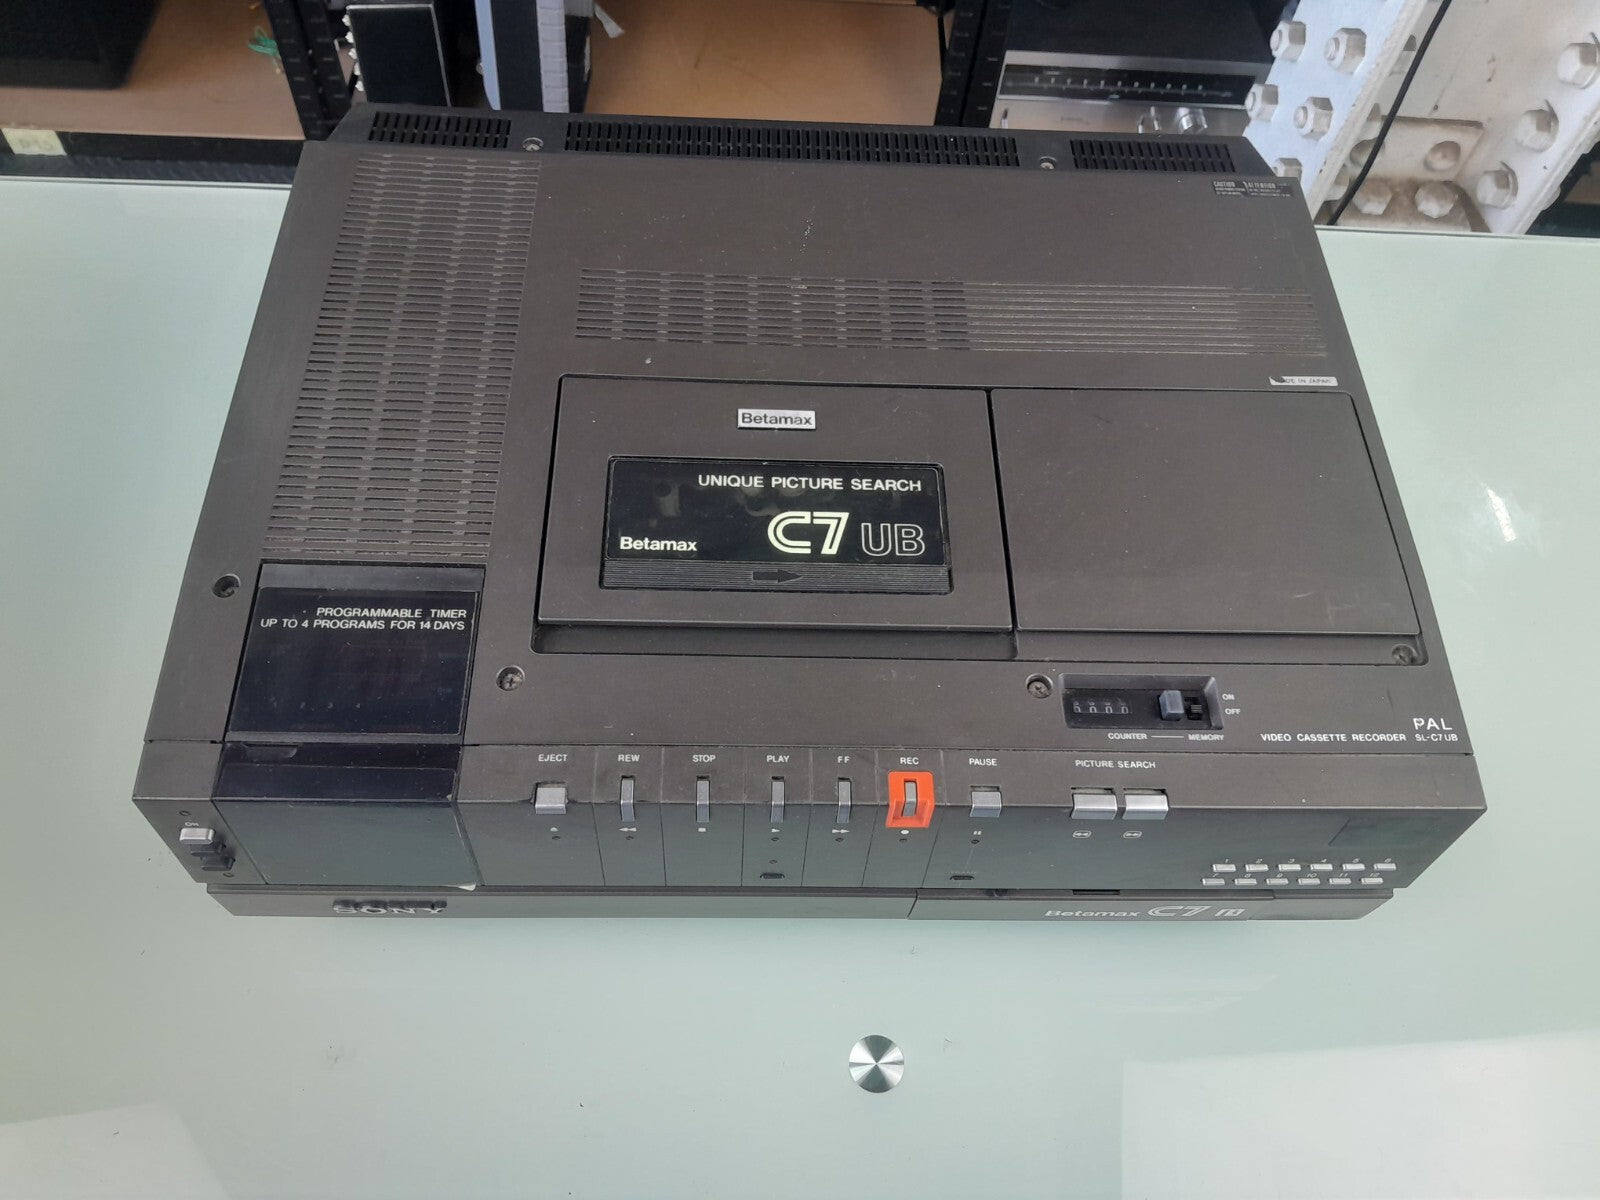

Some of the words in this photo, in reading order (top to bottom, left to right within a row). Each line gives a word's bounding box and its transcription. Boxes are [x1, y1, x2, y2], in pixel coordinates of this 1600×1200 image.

[741, 412, 813, 426] Betamax
[698, 474, 765, 489] UNIQUE
[771, 476, 844, 490] PICTURE
[850, 478, 922, 492] SEARCH
[767, 510, 850, 555] C7
[861, 522, 926, 557] UB
[620, 536, 698, 552] Betamax
[316, 607, 423, 618] PROGRAMMABLE
[430, 608, 467, 618] TIMER
[260, 618, 277, 628] UP
[282, 619, 298, 629] TO
[301, 619, 309, 628] 4
[313, 619, 386, 629] PROGRAMS
[390, 620, 416, 630] FOR
[420, 620, 431, 630] 14
[433, 620, 466, 630] DAYS
[1413, 717, 1453, 731] PAL
[1108, 732, 1148, 740] COUNTER
[1188, 733, 1225, 741] MEMORY
[1260, 733, 1292, 742] VIDEO
[1297, 733, 1348, 742] CASSETTE
[1352, 733, 1407, 742] RECORDER
[538, 754, 568, 763] EJECT
[618, 754, 640, 763] REW
[692, 754, 716, 763] STOP
[766, 755, 790, 763] PLAY
[900, 757, 920, 765] REC
[969, 758, 998, 766] PAUSE
[1075, 759, 1114, 768] PICTURE
[1117, 760, 1156, 769] SEARCH
[1044, 910, 1140, 918] Betamax
[1147, 905, 1213, 917] C7
